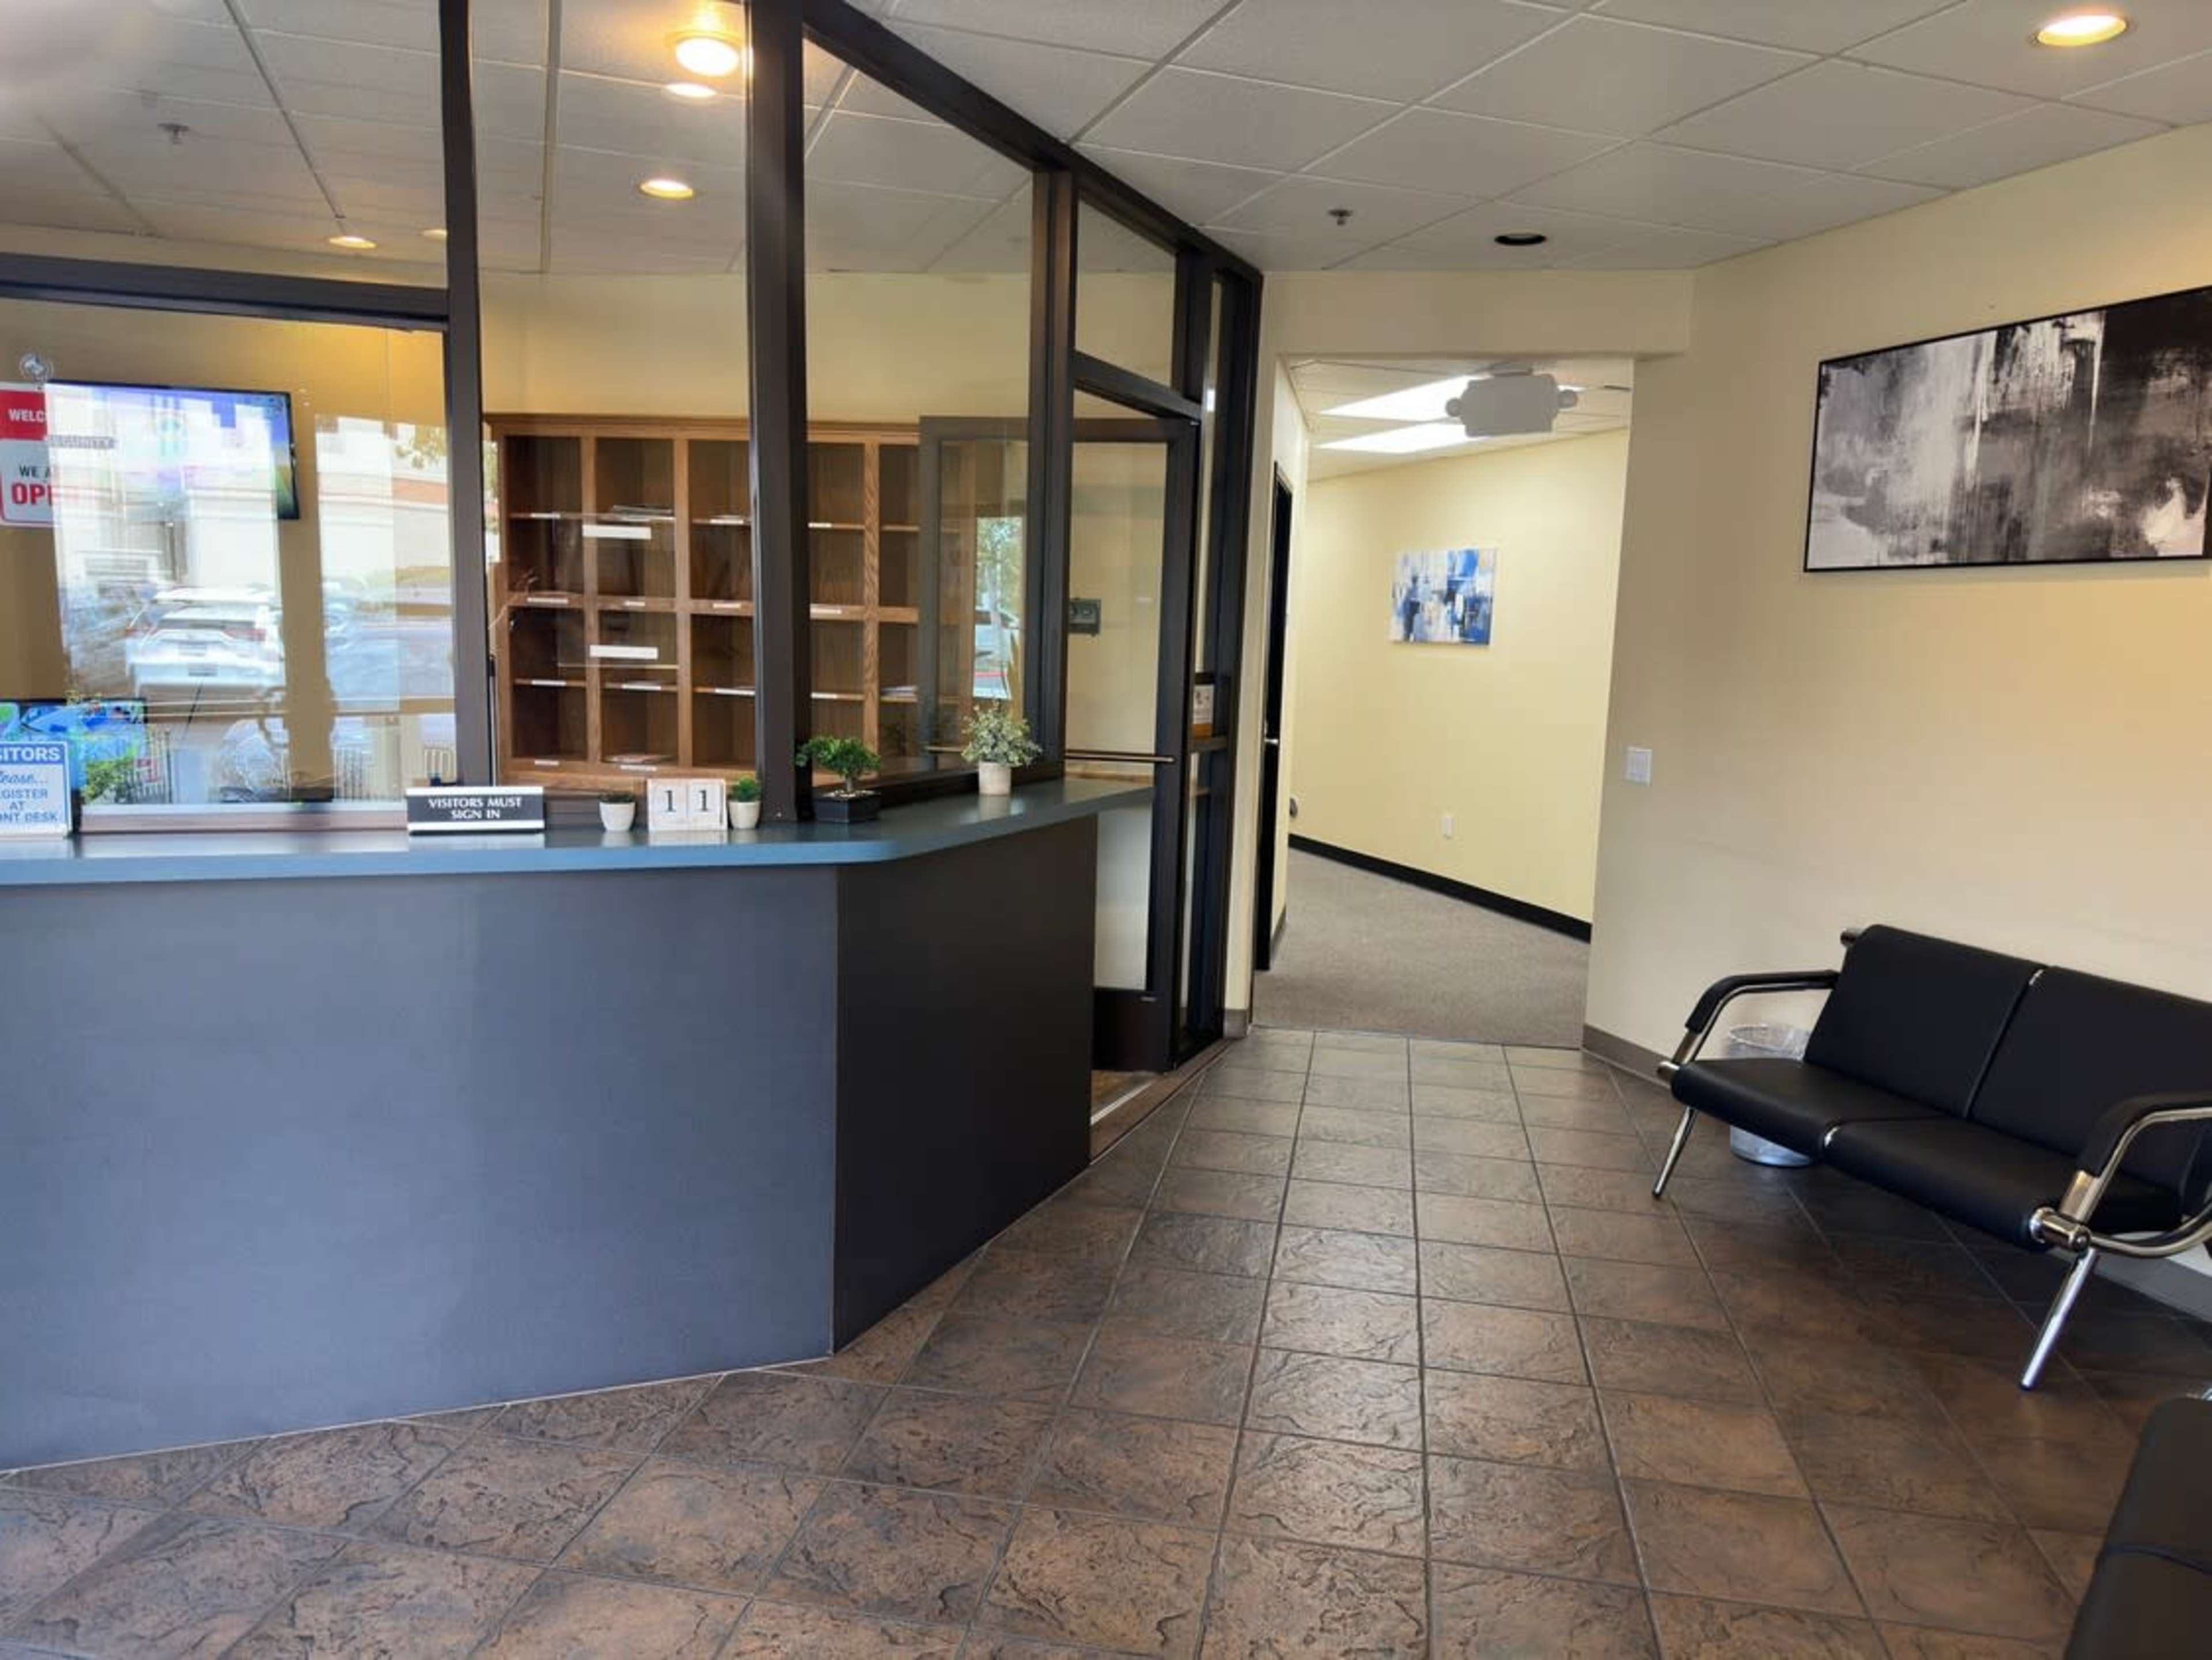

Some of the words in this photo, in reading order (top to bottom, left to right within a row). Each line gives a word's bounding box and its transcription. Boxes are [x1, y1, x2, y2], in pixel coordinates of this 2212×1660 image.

[20, 465, 36, 478] WE
[12, 482, 52, 505] OP
[0, 747, 60, 761] ITORS
[0, 788, 48, 799] GISTER
[10, 801, 24, 810] AT
[428, 796, 484, 808] VISITORS
[487, 796, 522, 807] MUST
[0, 812, 20, 822] NT
[25, 812, 58, 822] DESK
[451, 808, 482, 819] SIGN
[487, 809, 501, 819] IN
